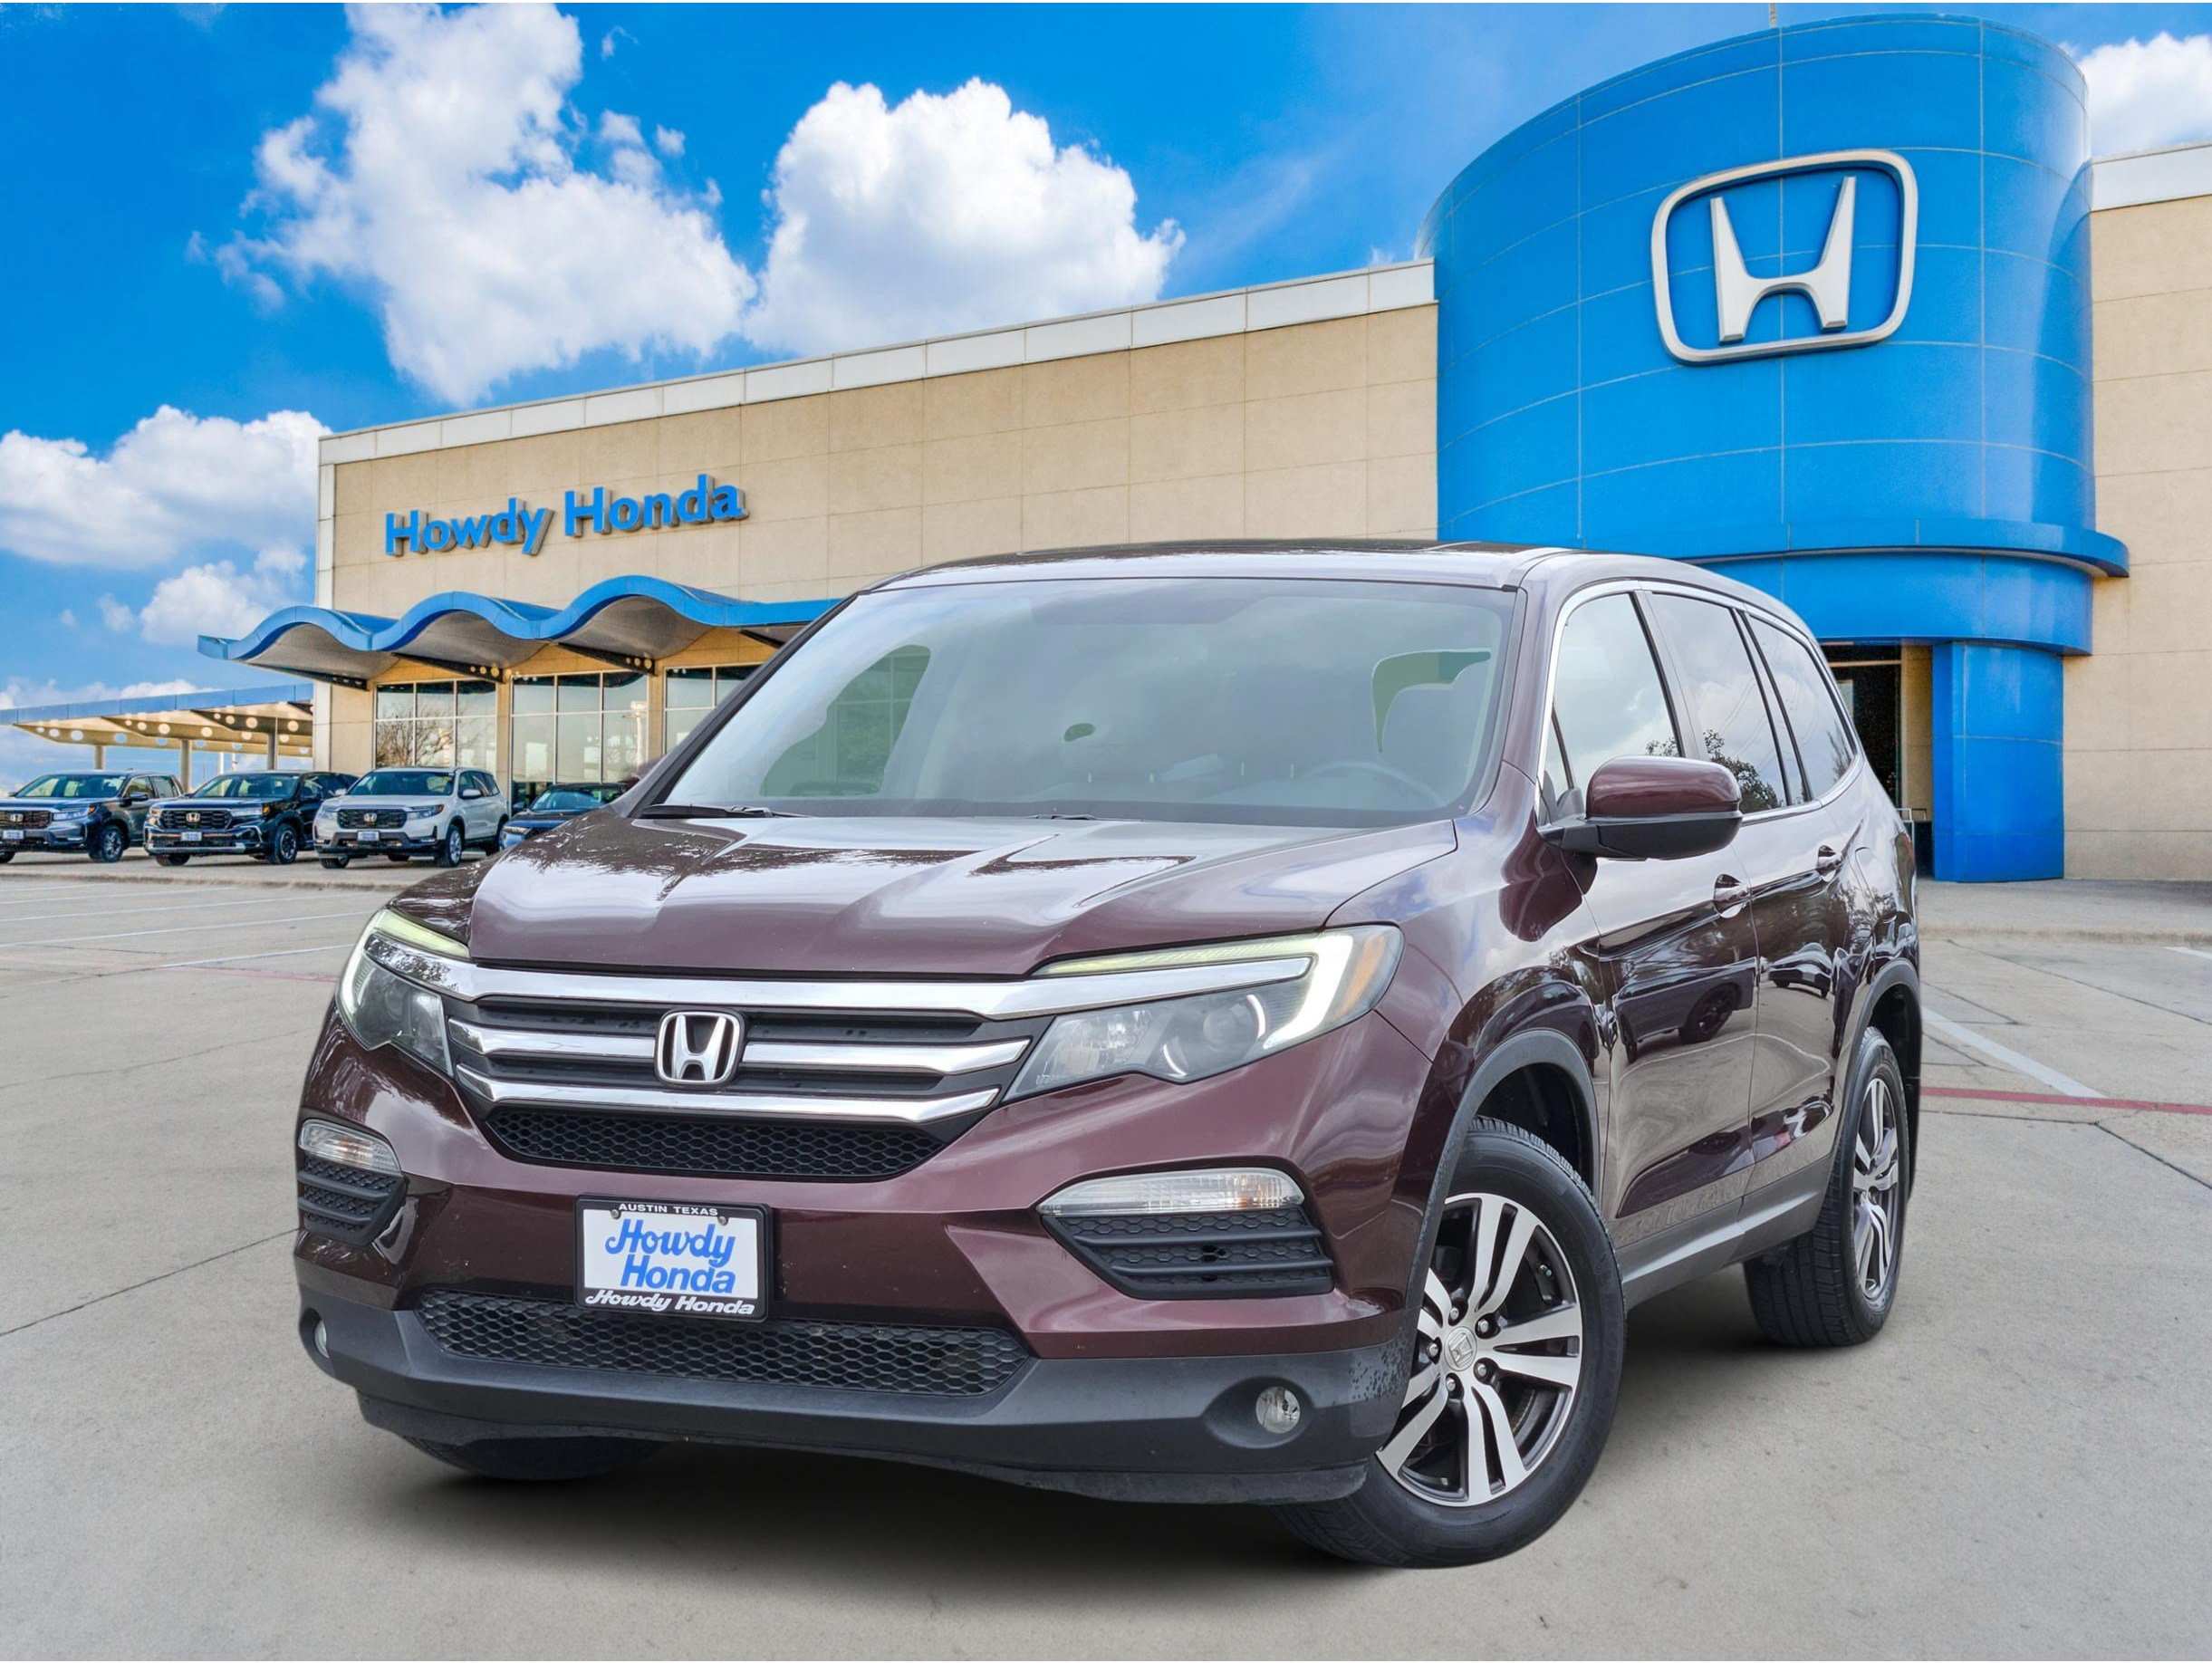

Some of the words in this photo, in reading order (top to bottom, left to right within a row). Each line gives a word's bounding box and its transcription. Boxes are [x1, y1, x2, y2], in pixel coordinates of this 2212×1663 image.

[385, 497, 553, 556] Howdy
[564, 474, 749, 537] Honda
[618, 1203, 668, 1214] AUSTIN
[673, 1206, 718, 1216] TEXAS
[604, 1217, 736, 1268] Howdy
[620, 1254, 736, 1294] Honda
[585, 1289, 672, 1312] Howdy
[674, 1295, 755, 1315] Honda
